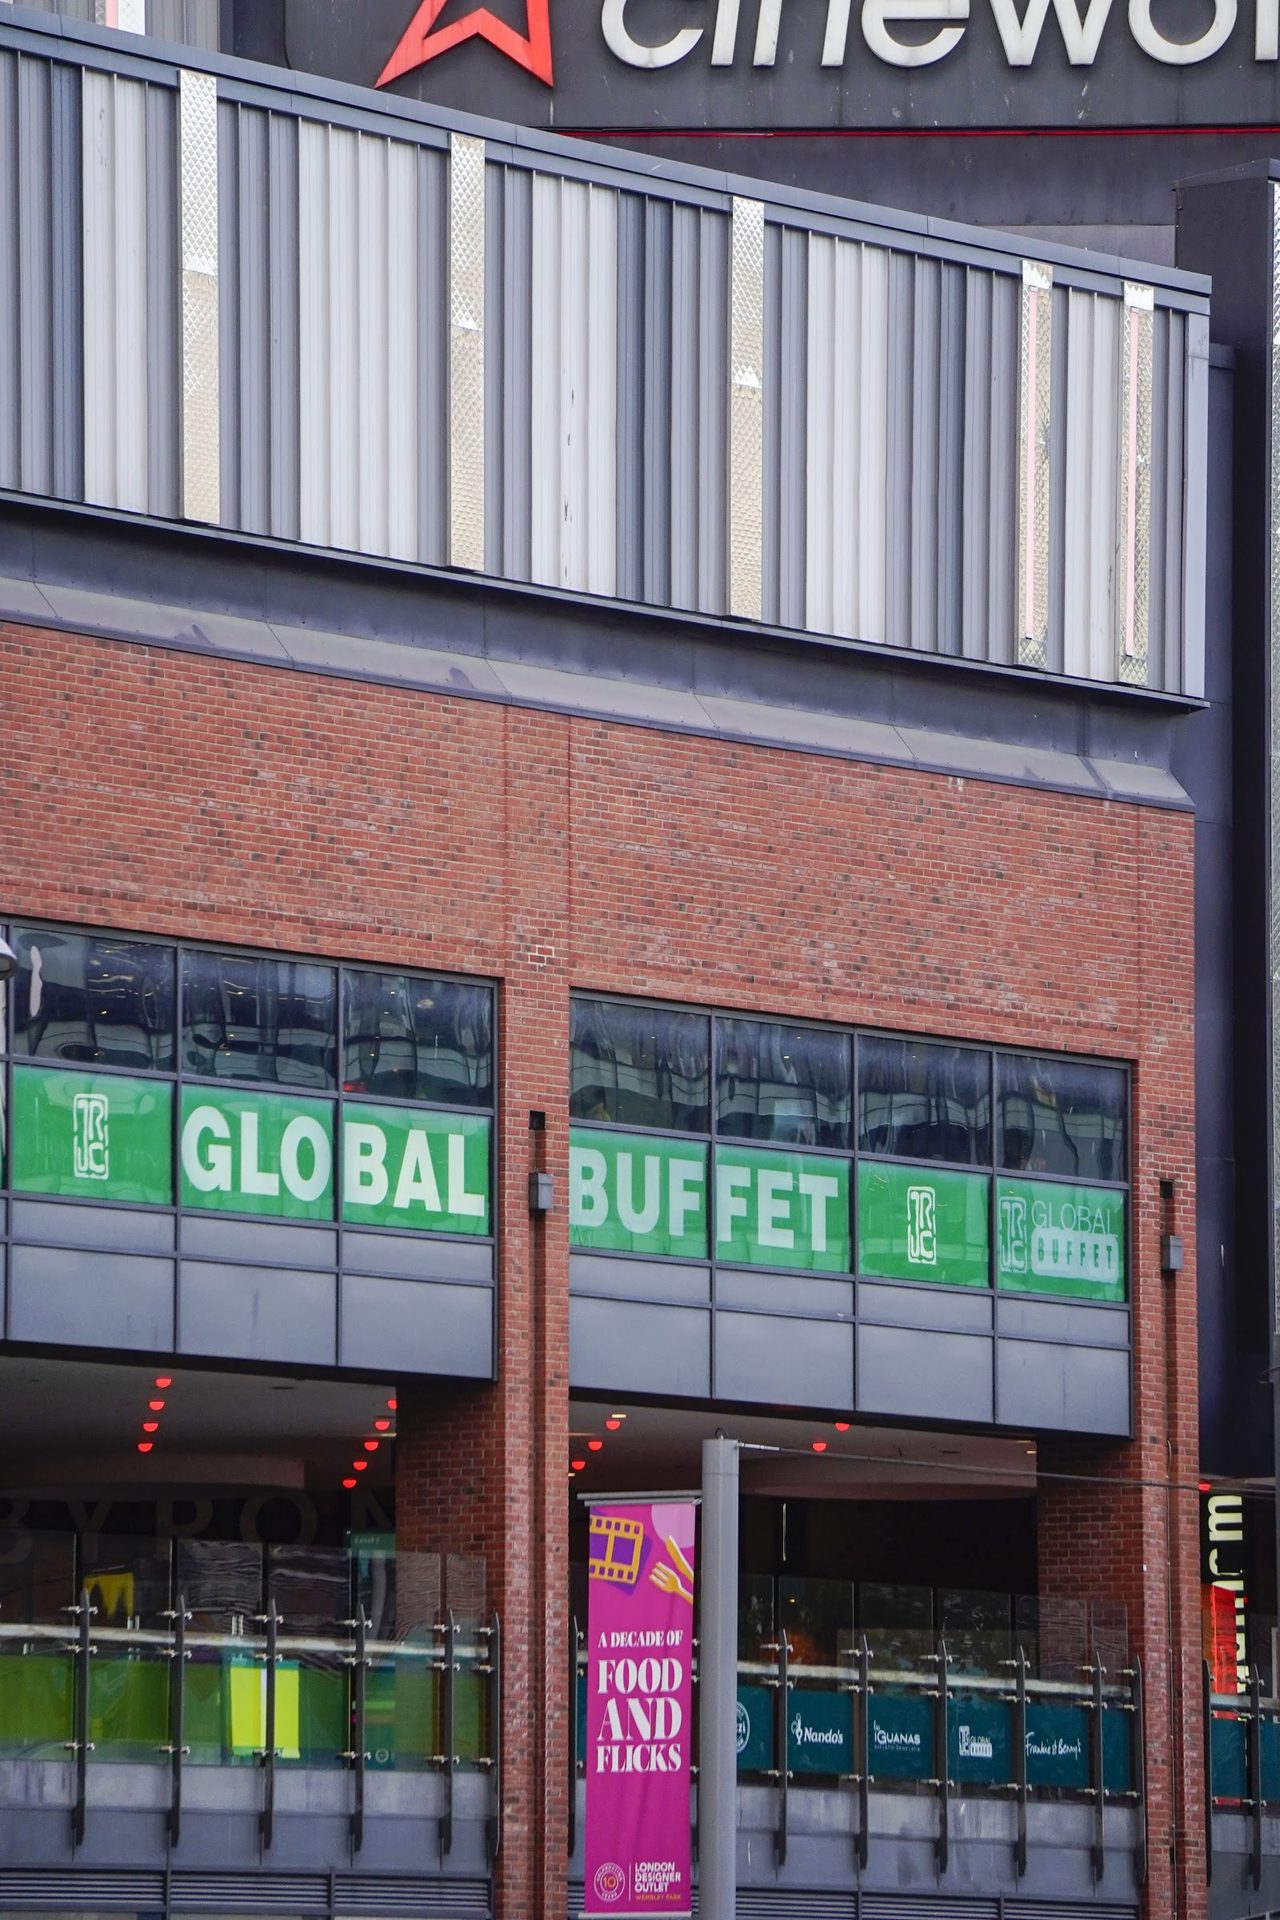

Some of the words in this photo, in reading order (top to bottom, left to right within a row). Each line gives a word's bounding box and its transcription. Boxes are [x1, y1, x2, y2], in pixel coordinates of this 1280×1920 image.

[180, 1105, 486, 1217] GLOBAL
[569, 1146, 839, 1252] BUFFET
[1031, 1200, 1118, 1235] GLOBAL
[1037, 1235, 1113, 1270] BUFFET
[598, 1631, 607, 1648] A
[610, 1630, 664, 1647] DECADE
[666, 1630, 683, 1646] OF
[598, 1657, 683, 1694] FOOD
[597, 1697, 682, 1741] AND
[803, 1727, 843, 1744] Nando's
[596, 1743, 682, 1773] FLICKS
[634, 1862, 675, 1872] LONDON
[634, 1872, 681, 1882] DESIGNER
[602, 1876, 617, 1888] 10
[634, 1882, 669, 1893] OUTLET
